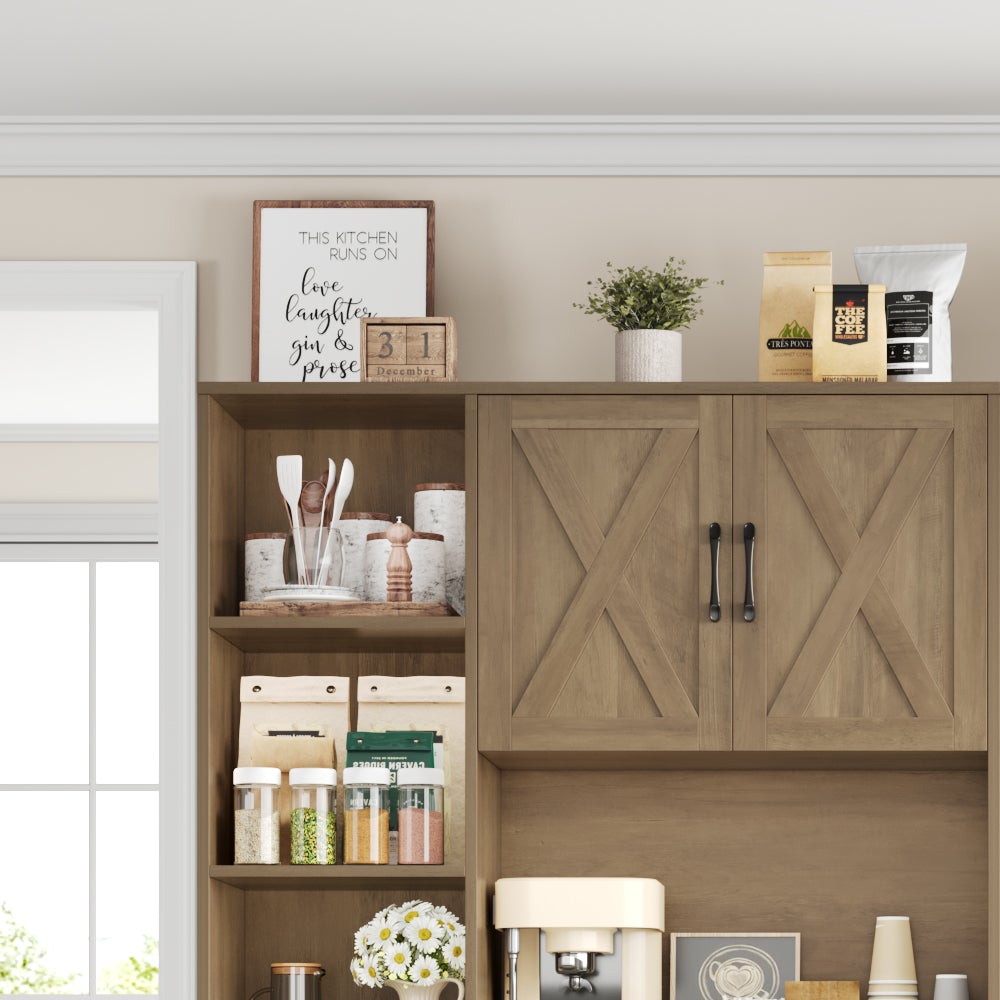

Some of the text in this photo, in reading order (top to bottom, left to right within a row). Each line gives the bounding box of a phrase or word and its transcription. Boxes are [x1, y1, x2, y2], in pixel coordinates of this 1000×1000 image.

[298, 231, 398, 245] THIS KITCHEN
[329, 247, 398, 261] RUNS ON
[301, 266, 343, 296] love
[285, 293, 378, 335] laughter
[834, 306, 865, 316] THE
[834, 316, 865, 325] COF
[834, 325, 865, 334] FEE
[288, 328, 354, 367] gin &
[376, 366, 436, 376] December
